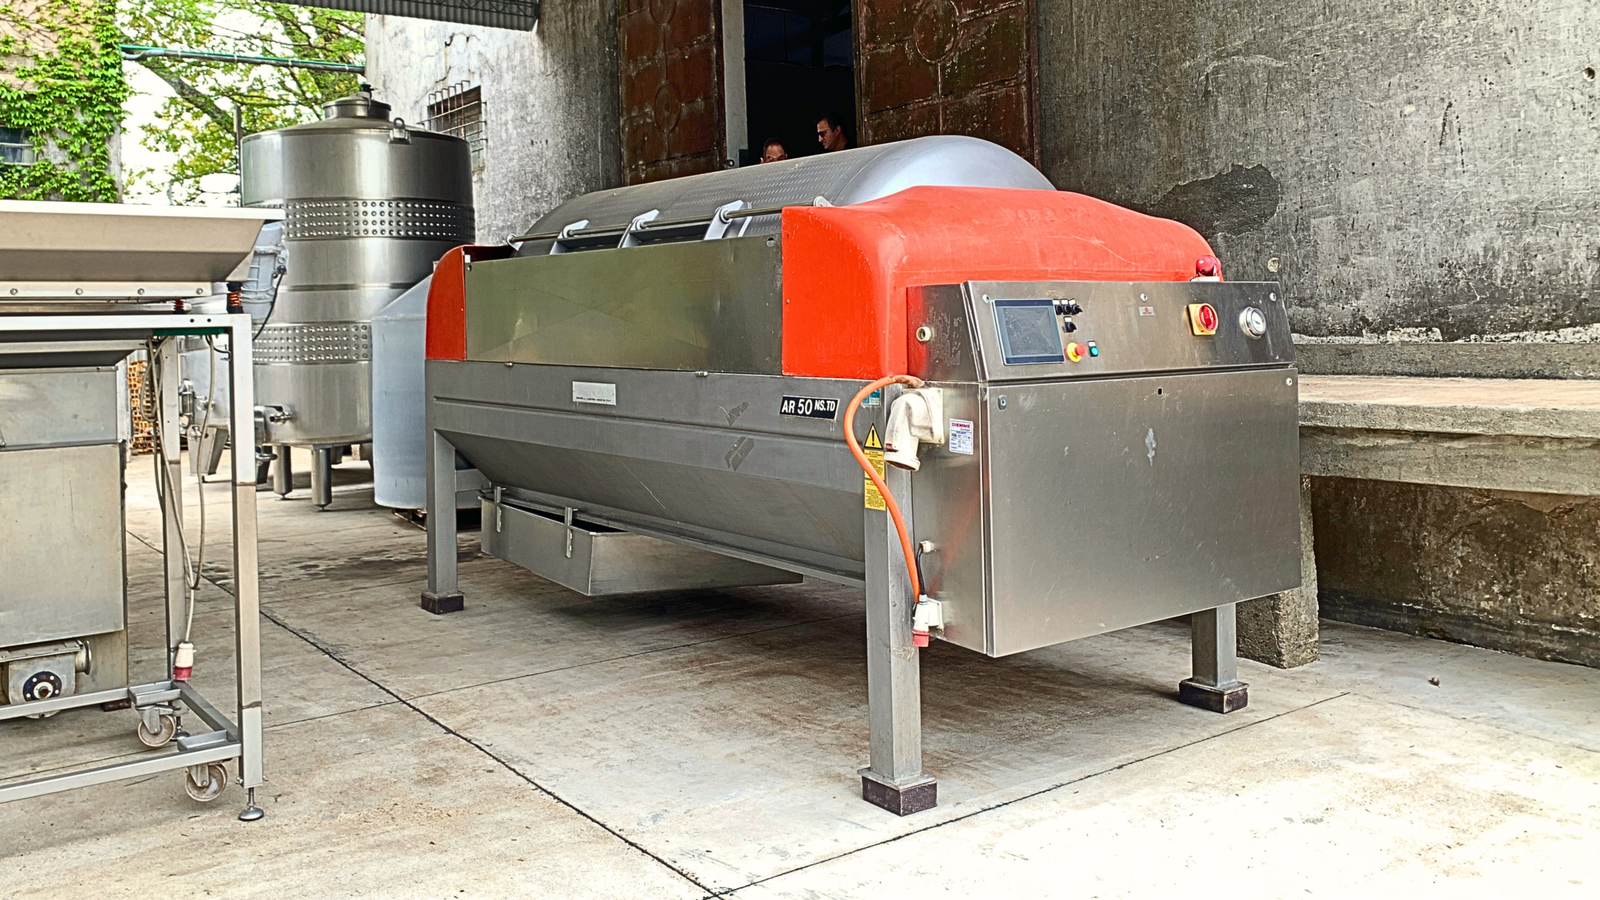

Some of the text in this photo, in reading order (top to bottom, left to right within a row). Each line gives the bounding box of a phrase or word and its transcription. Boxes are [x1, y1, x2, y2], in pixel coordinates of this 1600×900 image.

[781, 398, 835, 415] AR 50 NS.TD
